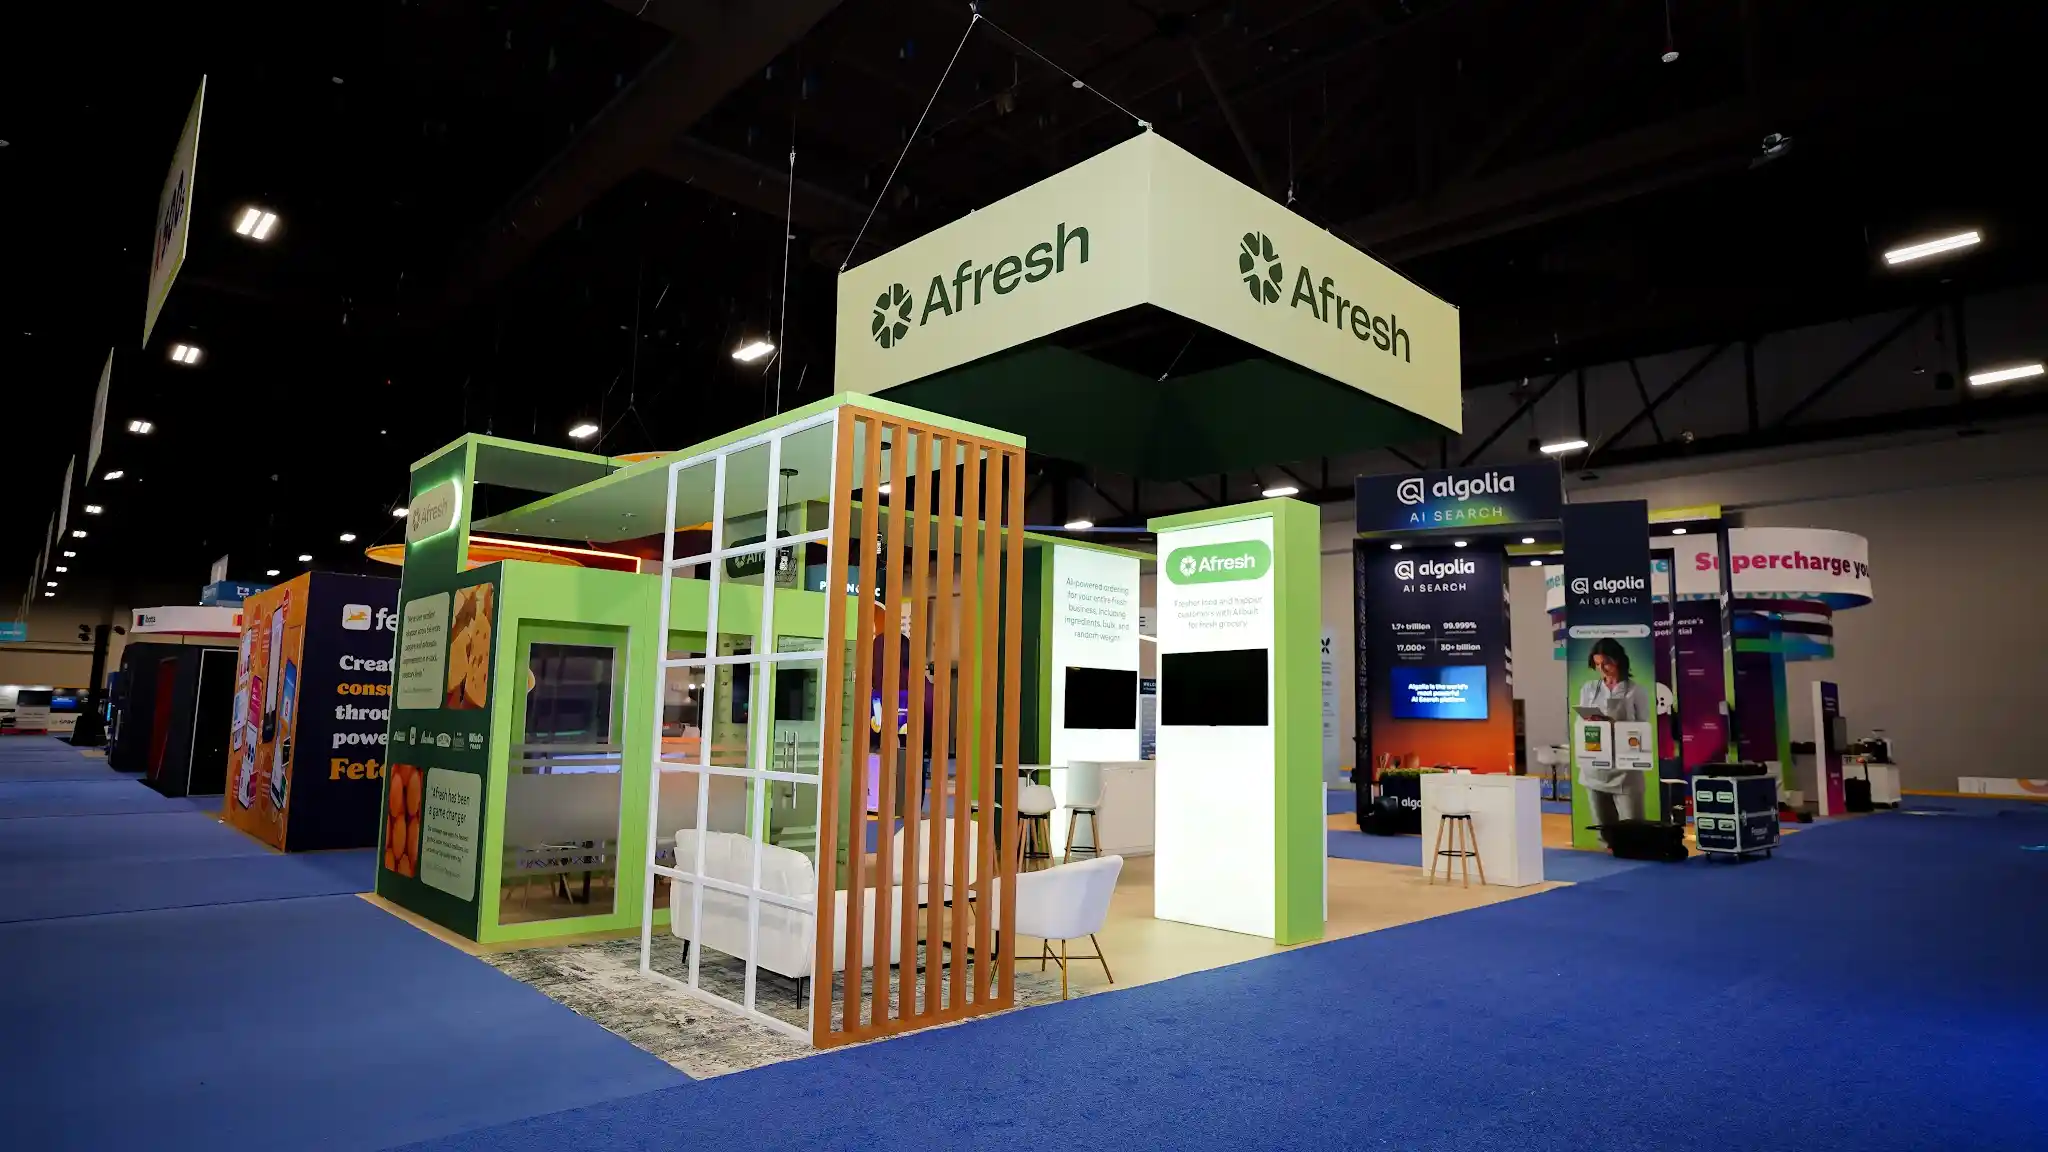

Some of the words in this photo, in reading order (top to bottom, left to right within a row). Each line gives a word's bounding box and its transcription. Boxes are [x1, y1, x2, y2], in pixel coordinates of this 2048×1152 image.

[919, 221, 1089, 327] Afresh
[1290, 265, 1411, 364] Afresh
[1432, 471, 1515, 501] algolia
[1409, 512, 1426, 523] AI
[1434, 506, 1503, 522] SEARCH
[1198, 552, 1256, 573] Afresh
[1418, 558, 1475, 579] algolia
[1403, 585, 1415, 594] AI
[1419, 582, 1467, 593] SEARCH
[1593, 576, 1645, 593] algolia
[1067, 590, 1078, 599] for
[1079, 594, 1093, 603] your
[1579, 597, 1591, 606] AI
[1594, 596, 1638, 606] SEARCH
[1406, 622, 1431, 631] trillion
[1443, 621, 1477, 630] 99.999%
[1396, 644, 1426, 652] 17,000+
[1456, 643, 1481, 651] billion
